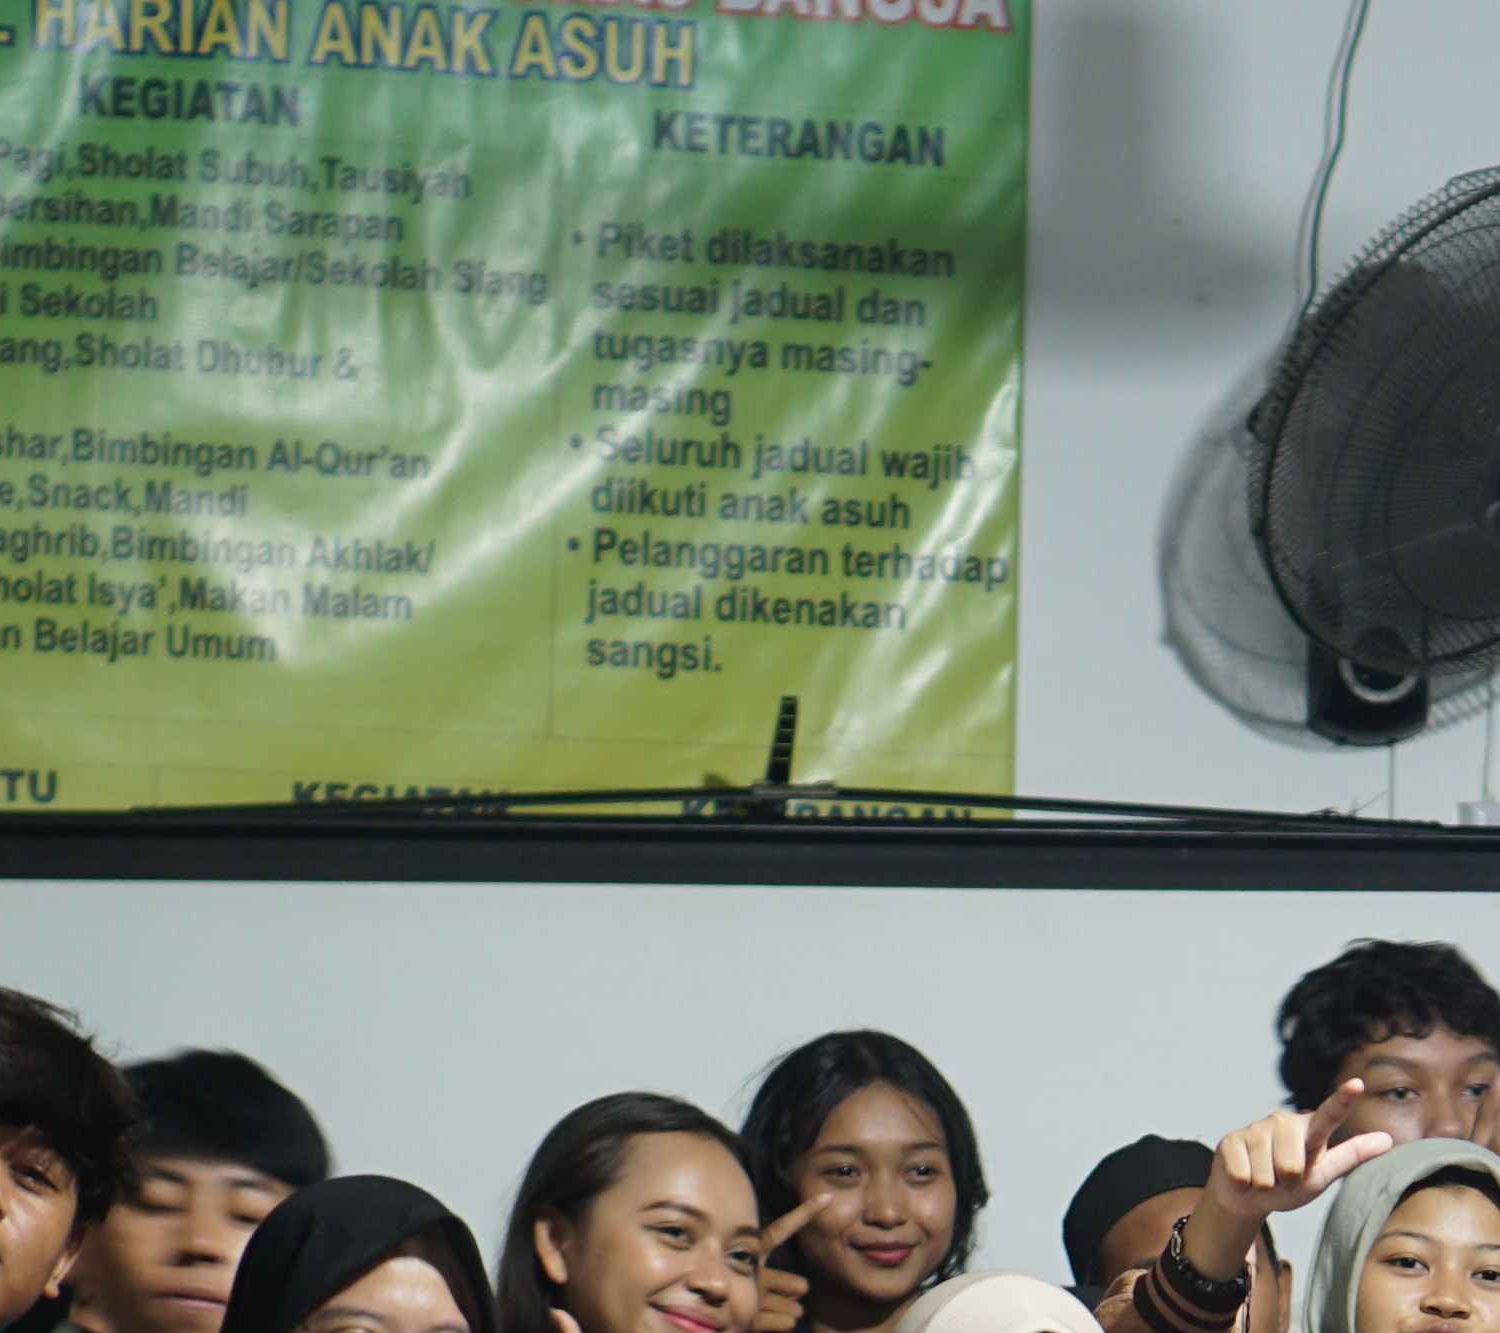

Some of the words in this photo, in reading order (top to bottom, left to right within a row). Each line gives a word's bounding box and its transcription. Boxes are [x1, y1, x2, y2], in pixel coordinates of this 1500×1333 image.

[34, 0, 290, 62] HARIAN
[308, 1, 498, 76] ANAK
[510, 12, 698, 88] ASUH
[79, 74, 299, 126] KEGIATAN
[654, 109, 945, 167] KETERANGAN
[264, 200, 406, 252] Sarapan
[597, 222, 695, 264] Piket
[704, 230, 955, 278] dilaksanakan
[19, 283, 158, 321] Sekolah
[452, 260, 548, 305] Siang
[595, 278, 718, 314] sesuai
[729, 280, 844, 324] jadual
[857, 288, 925, 326] dan
[334, 348, 358, 380] &
[593, 331, 768, 376] tugasnya
[592, 382, 732, 426] masing
[597, 425, 740, 469] Seluruh
[751, 434, 868, 479] jadual
[881, 445, 974, 490] wajib
[591, 477, 706, 518] diikuti
[719, 487, 808, 524] anak
[821, 495, 910, 529] asuh
[593, 528, 830, 580] Pelanggaran
[842, 545, 1007, 592] terhadap
[302, 582, 413, 619] Malam
[584, 579, 699, 624] jadual
[715, 588, 906, 630] dikenakan
[34, 616, 154, 663] Belajar
[166, 624, 277, 660] Umum
[587, 635, 721, 678] sangsi.
